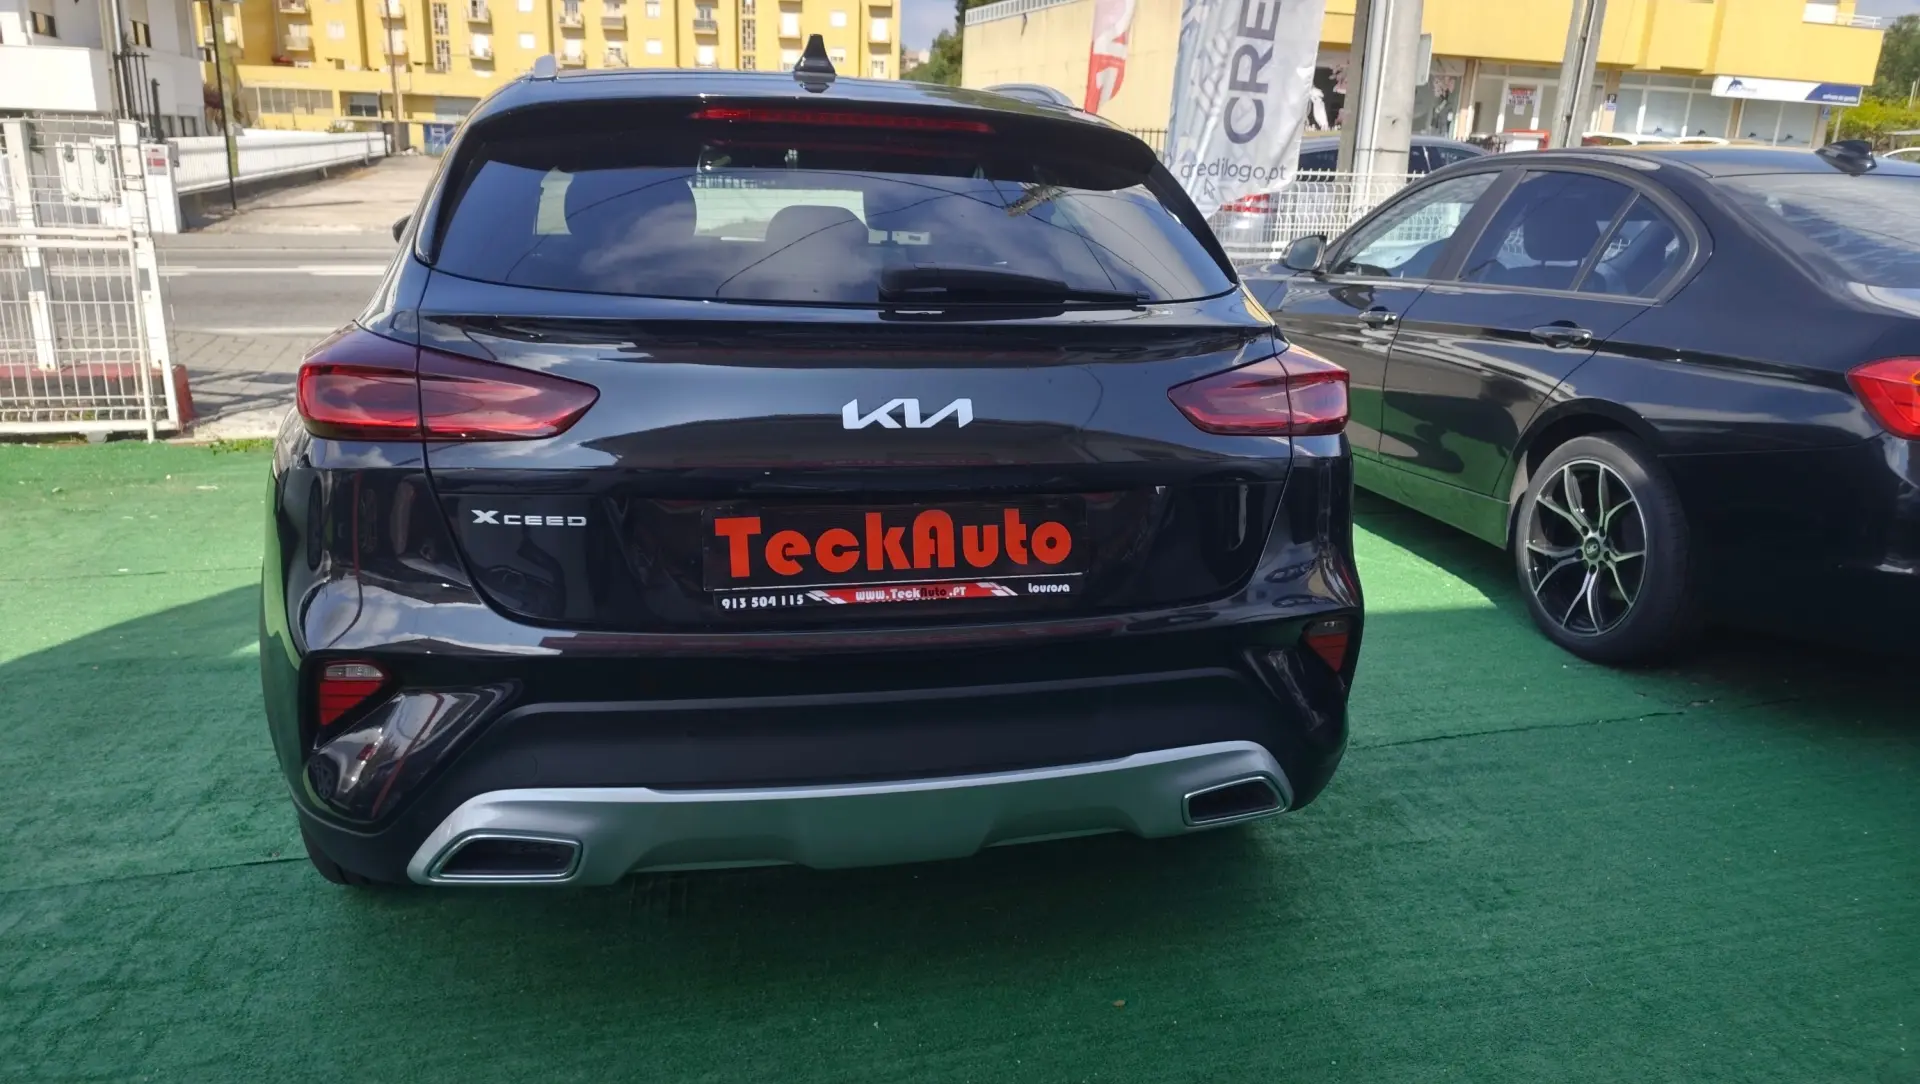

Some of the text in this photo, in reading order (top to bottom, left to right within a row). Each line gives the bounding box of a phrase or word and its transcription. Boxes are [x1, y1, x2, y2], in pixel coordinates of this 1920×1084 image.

[1223, 0, 1282, 145] CRE
[1180, 157, 1288, 185] credilogo.pt
[841, 398, 974, 430] KIA
[470, 509, 588, 527] XCEED
[714, 507, 1072, 578] TeckAuto
[721, 594, 804, 609] 913 504 115
[1027, 582, 1071, 594] Lourosa
